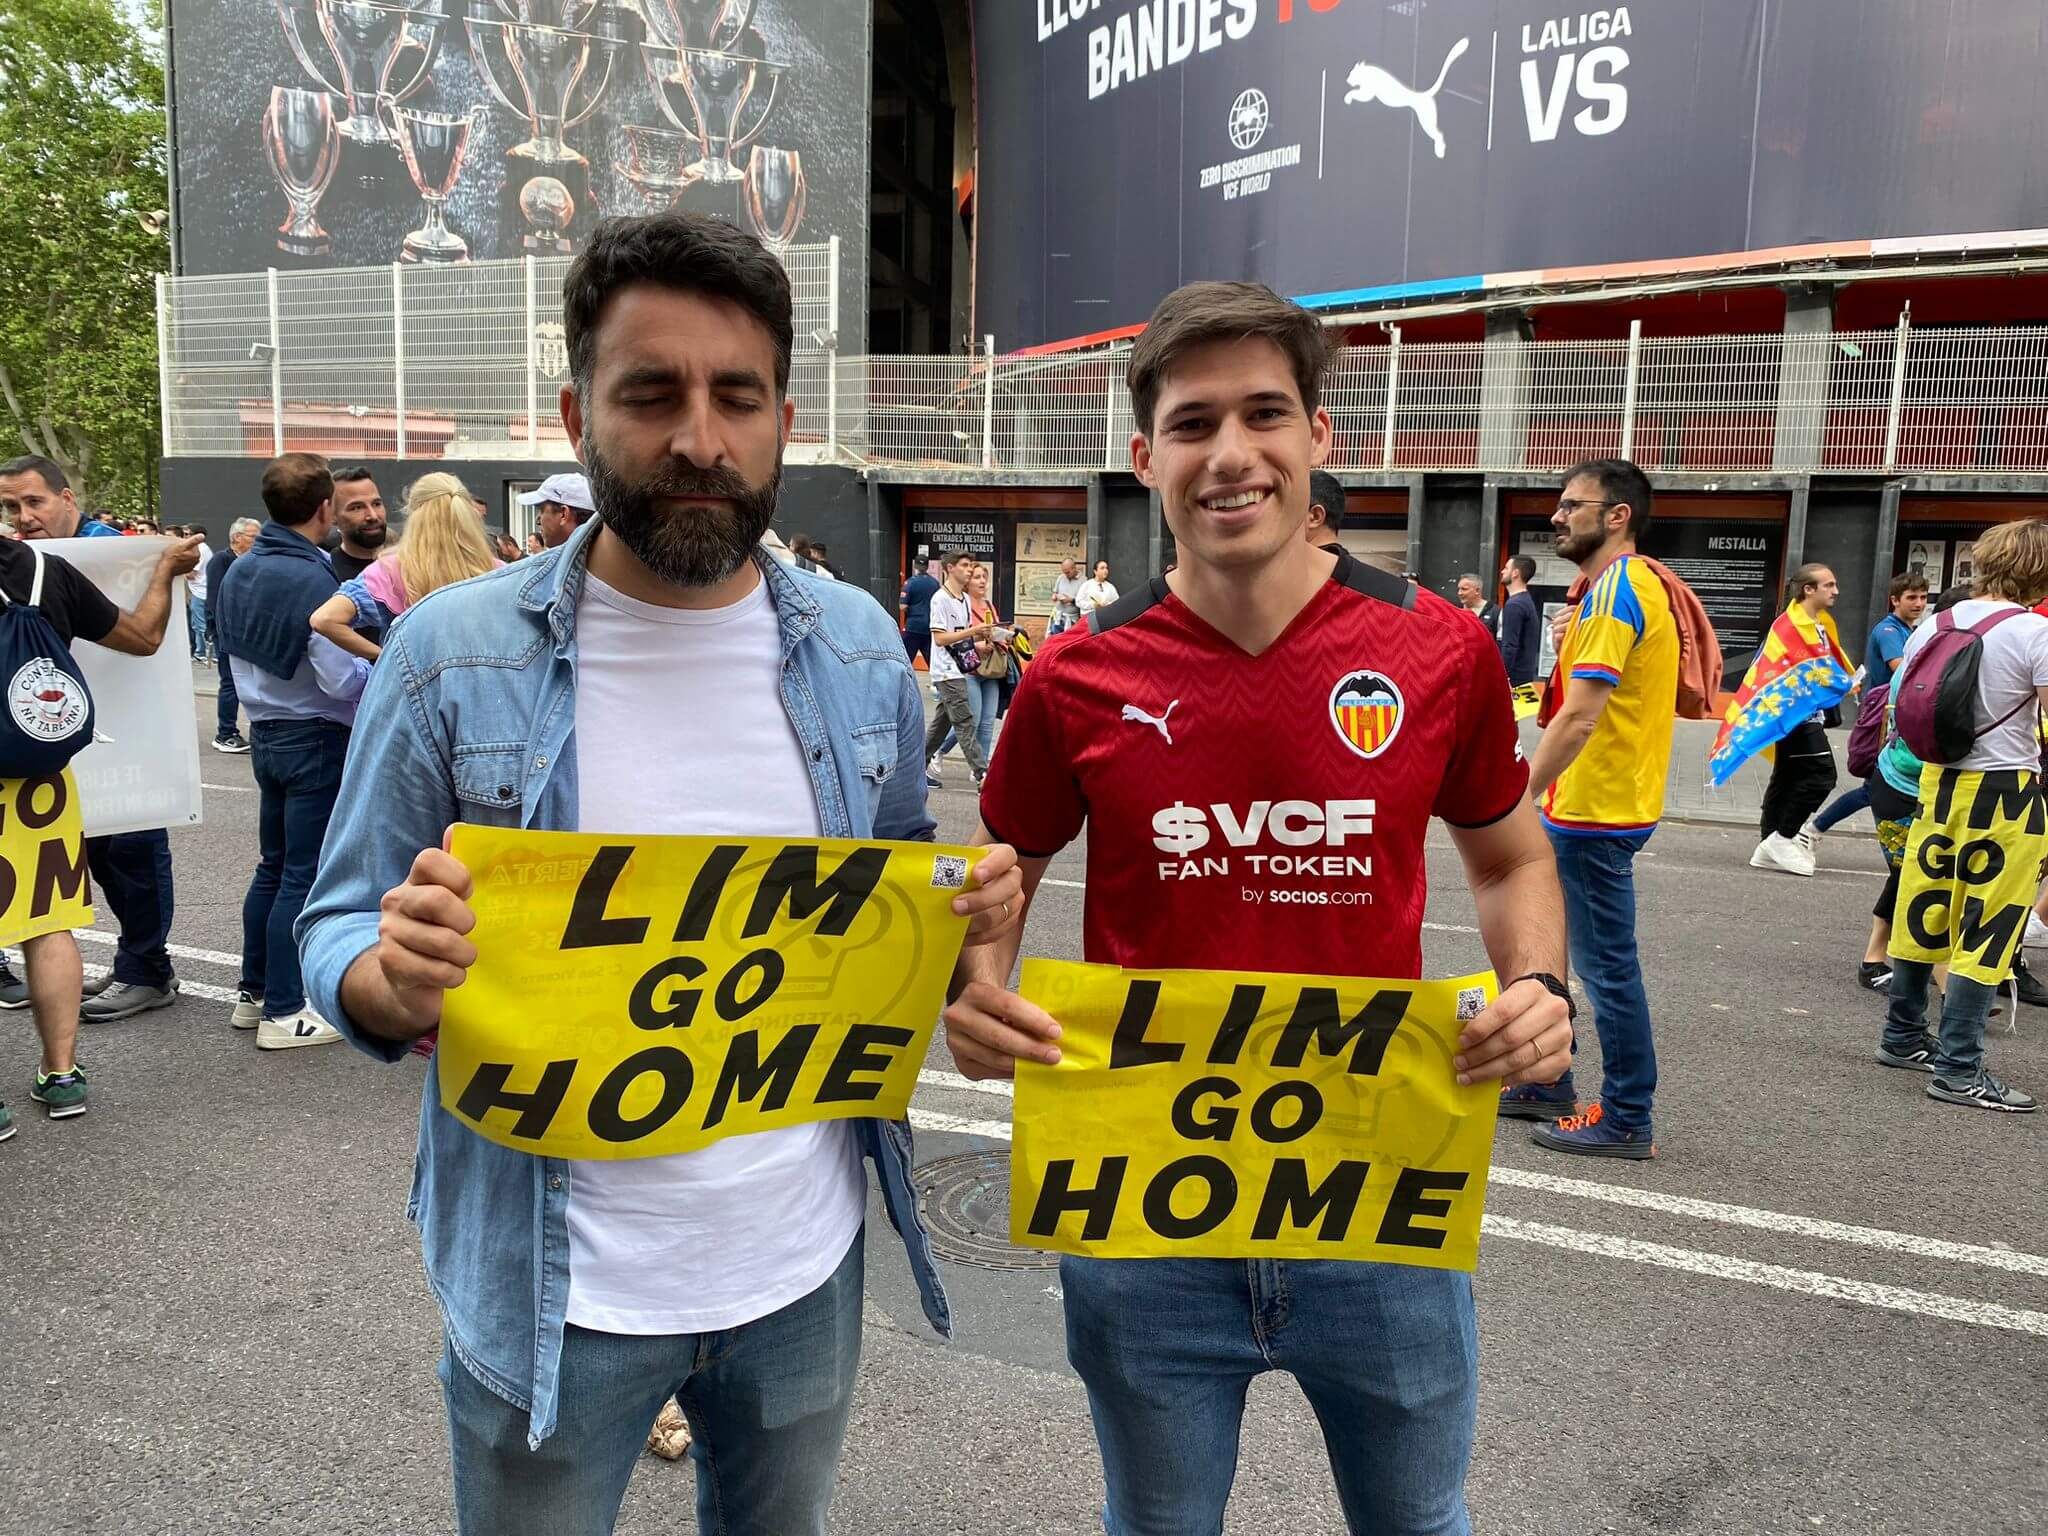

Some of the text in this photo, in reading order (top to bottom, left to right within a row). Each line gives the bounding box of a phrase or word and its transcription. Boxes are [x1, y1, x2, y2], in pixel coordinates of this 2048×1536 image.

[1088, 0, 1258, 100] BANDES
[1521, 6, 1633, 54] LALIGA
[1519, 45, 1632, 143] VS
[1200, 143, 1301, 188] ZERO DISCRIMINATION
[1223, 172, 1271, 201] VCF WORLD
[913, 522, 994, 534] ENTRADAS MESTALLA
[932, 534, 994, 543] ENTRADES MESTALLA
[969, 544, 994, 553] TICKETS
[1708, 537, 1767, 551] MESTALLA
[1152, 799, 1376, 857] $VCF
[1158, 855, 1373, 881] FAN TOKEN
[1917, 833, 2006, 886] GO
[558, 844, 893, 950] LIM
[1242, 886, 1264, 904] by
[627, 948, 785, 1031] GO
[1109, 979, 1413, 1076] LIM
[455, 1023, 916, 1143] HOME
[1171, 1076, 1325, 1144] GO
[1026, 1154, 1470, 1250] HOME
